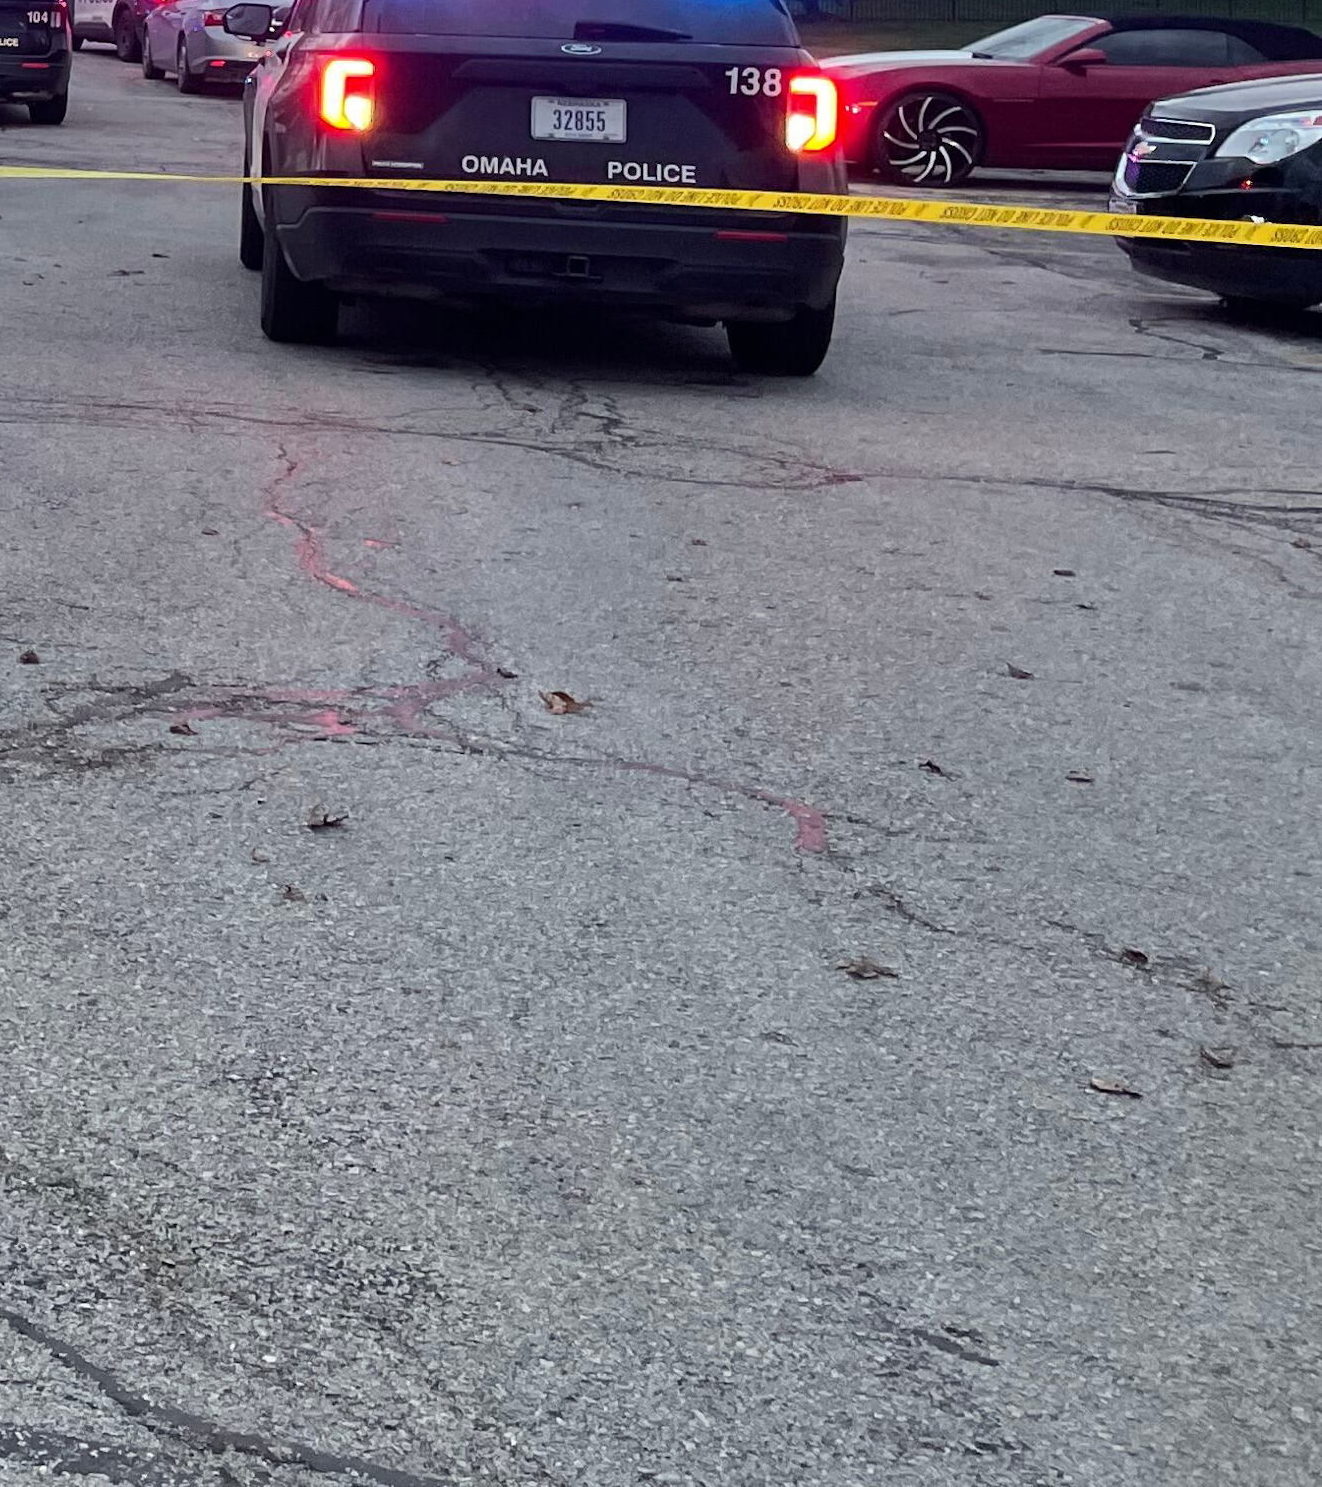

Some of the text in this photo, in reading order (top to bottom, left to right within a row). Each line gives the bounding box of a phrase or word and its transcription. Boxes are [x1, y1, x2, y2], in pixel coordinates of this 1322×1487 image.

[26, 11, 48, 24] 104
[725, 66, 782, 97] 138
[552, 109, 607, 132] 32855
[461, 154, 697, 184] OMAHA POLICE
